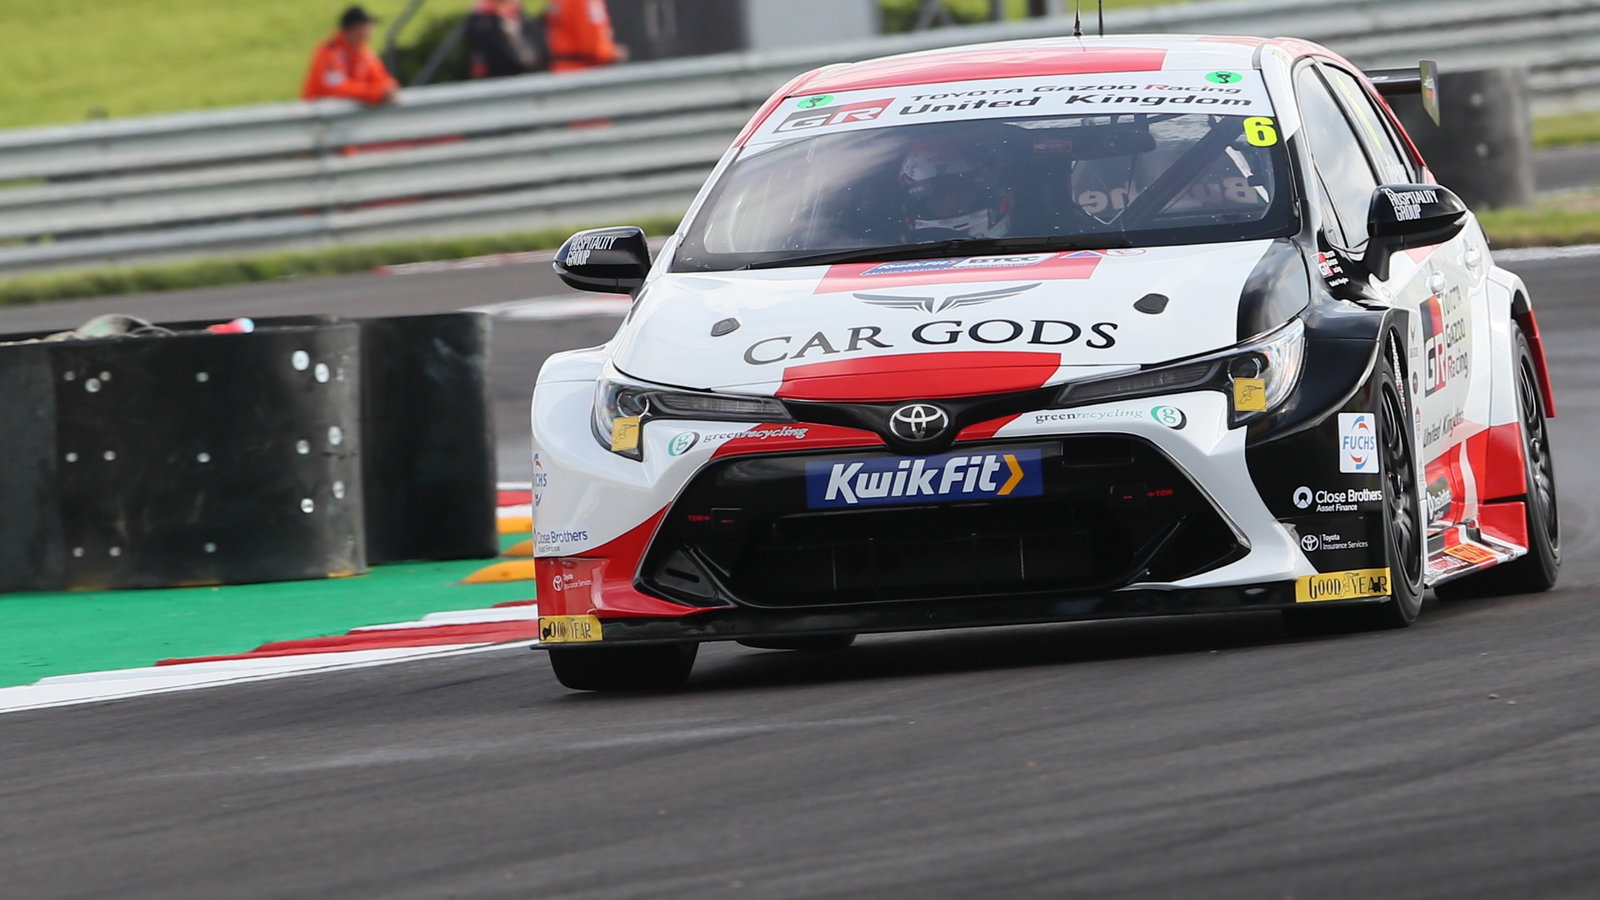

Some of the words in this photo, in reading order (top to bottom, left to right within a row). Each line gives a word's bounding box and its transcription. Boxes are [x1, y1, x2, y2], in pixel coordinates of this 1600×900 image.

[911, 87, 1023, 101] TOYOTA
[1033, 84, 1136, 93] GAZOO
[1144, 84, 1242, 94] Racing
[899, 97, 1041, 115] United
[1065, 94, 1252, 106] Kingdom
[776, 105, 886, 133] GR
[1242, 116, 1278, 147] 6
[1381, 188, 1439, 206] HOSPITALITY
[1394, 204, 1421, 221] GROUP
[566, 250, 590, 266] GROUP
[743, 326, 893, 366] CAR
[911, 319, 1118, 349] GODS
[1445, 319, 1466, 348] GAZOO
[1425, 332, 1447, 392] GR
[1447, 350, 1468, 379] Racing
[1423, 419, 1442, 448] United
[1343, 436, 1375, 451] FUCHS
[1315, 490, 1346, 503] Close
[1347, 488, 1382, 502] Brothers
[1316, 504, 1335, 512] Asset
[1335, 503, 1358, 511] Finance
[550, 530, 589, 543] Brothers
[1322, 534, 1340, 542] Toyota
[1348, 540, 1368, 548] Services
[1309, 575, 1340, 600] GOOD
[570, 622, 592, 640] YEAR
